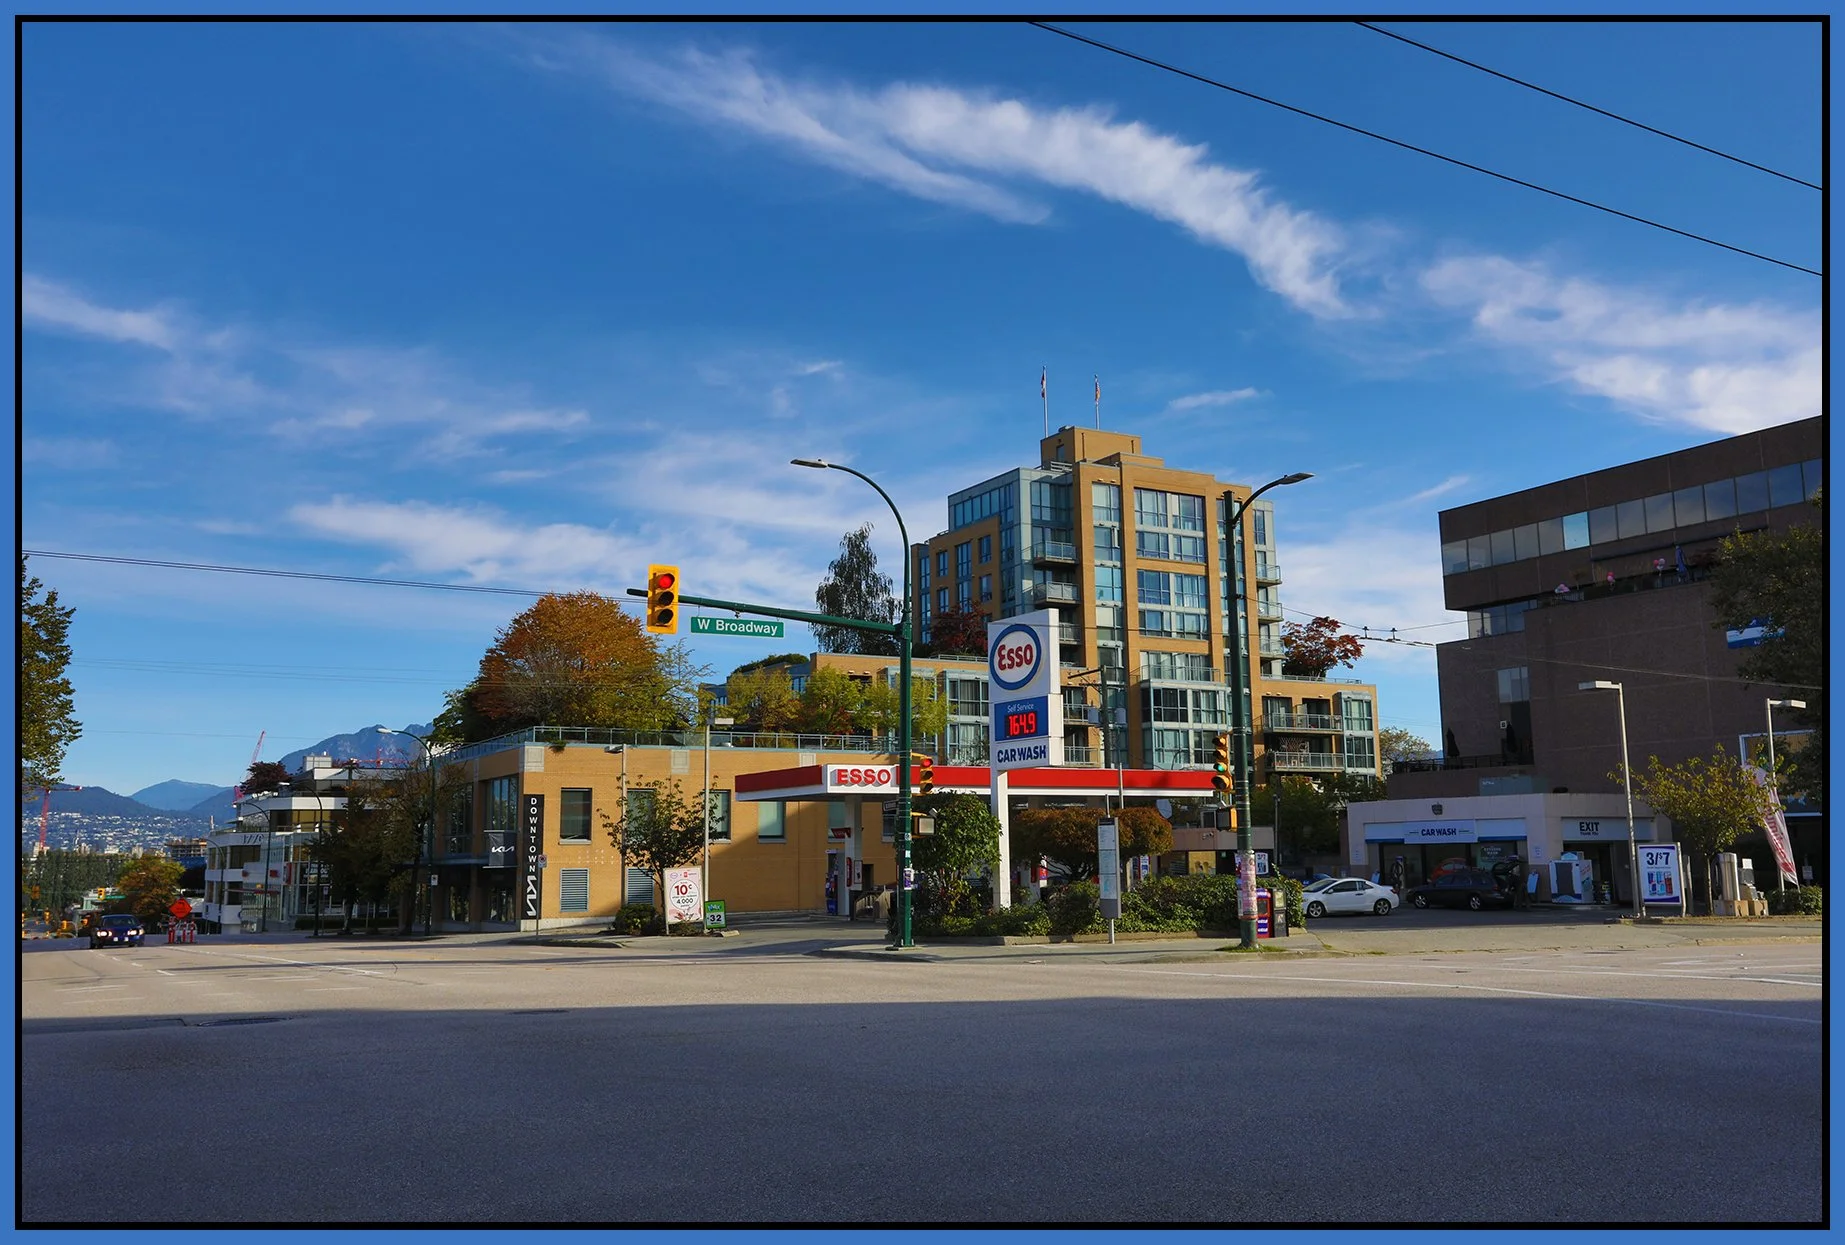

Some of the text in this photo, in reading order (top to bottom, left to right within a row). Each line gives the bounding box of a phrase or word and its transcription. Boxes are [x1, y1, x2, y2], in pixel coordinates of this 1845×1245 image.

[697, 618, 778, 636] W Broadway
[1007, 702, 1034, 714] Self Service
[1008, 712, 1036, 736] 164.9
[997, 745, 1047, 763] CAR WASH
[836, 768, 891, 785] ESSO
[528, 797, 538, 873] DOWNTOWN
[1421, 827, 1457, 837] CAR WASH
[1579, 821, 1600, 832] EXIT
[1646, 852, 1671, 866] 3/$7
